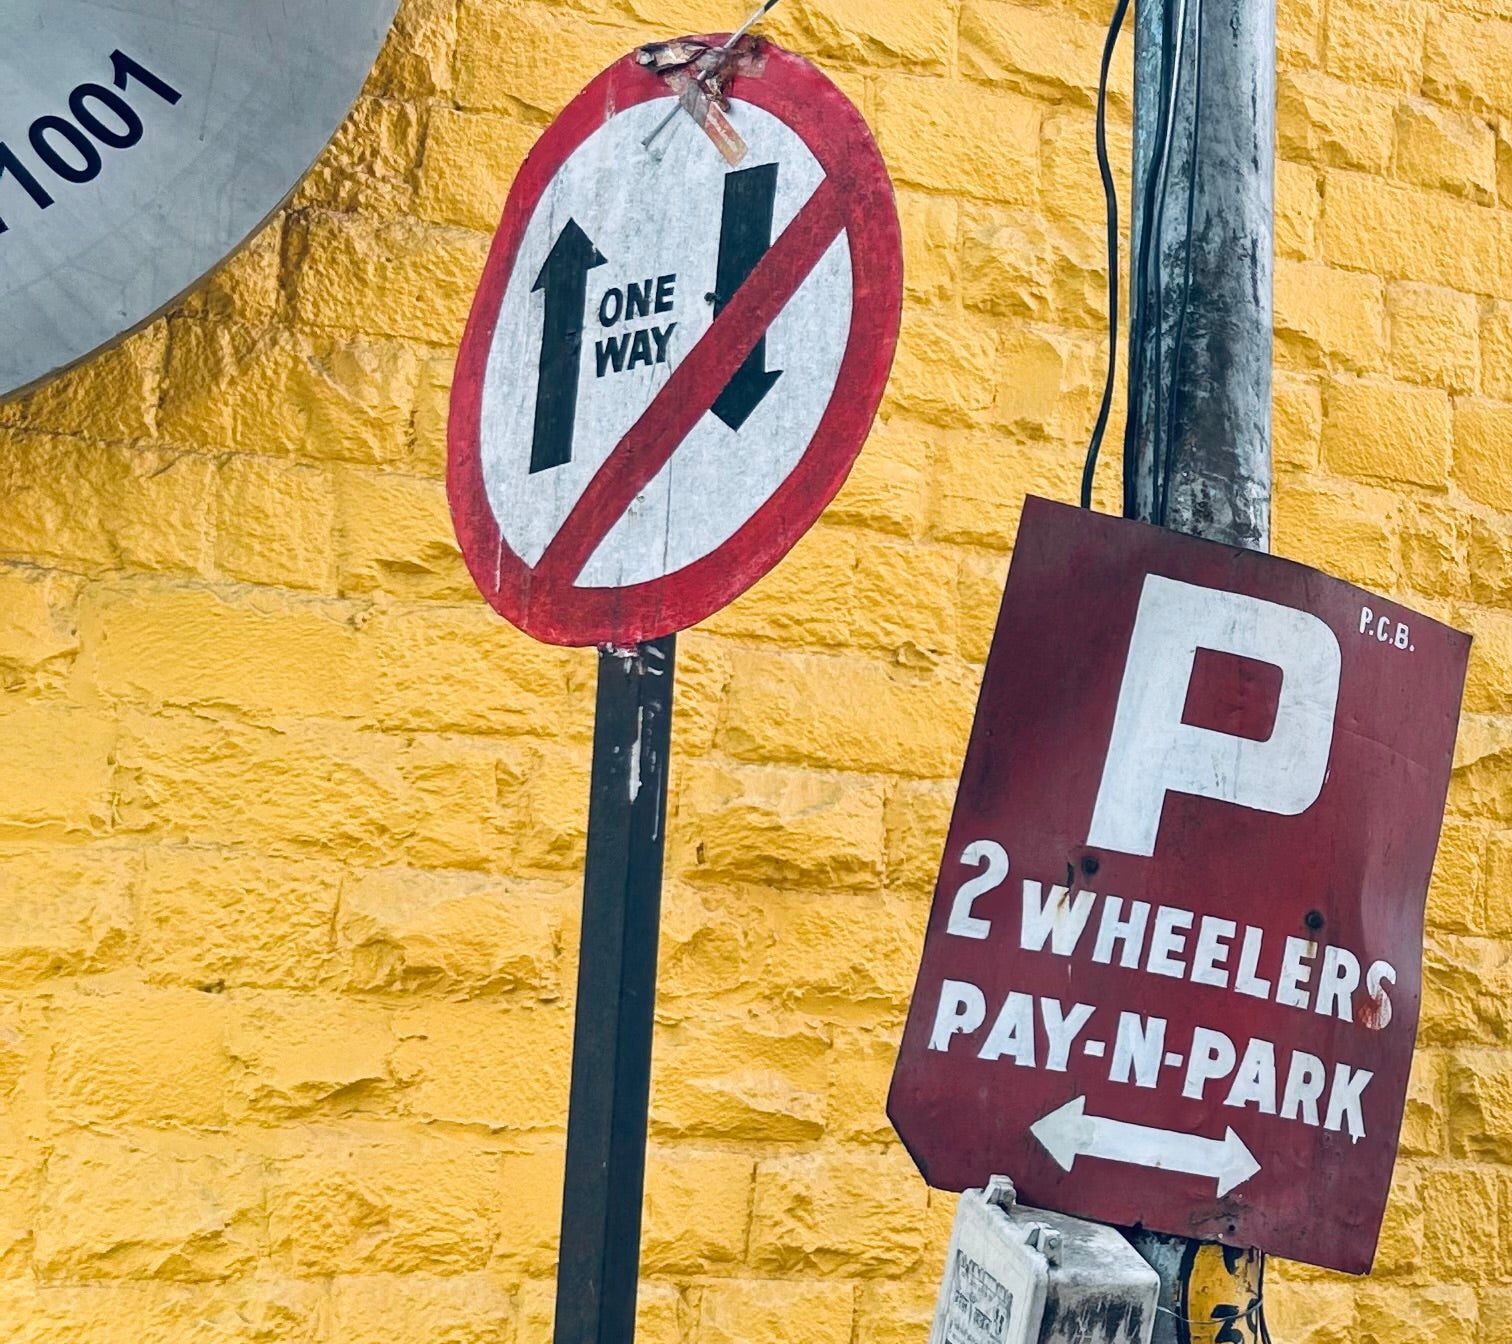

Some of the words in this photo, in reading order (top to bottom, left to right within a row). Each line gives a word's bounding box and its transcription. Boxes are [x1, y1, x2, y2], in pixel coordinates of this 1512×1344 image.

[0, 48, 183, 234] 1001
[595, 322, 678, 378] WAY
[598, 272, 677, 328] ONE
[1359, 606, 1415, 652] P.C.B.
[1086, 572, 1343, 857] P
[945, 839, 1010, 940] 2
[1018, 878, 1399, 1032] WHEELERS
[926, 978, 1375, 1145] PAY-N-PARK
